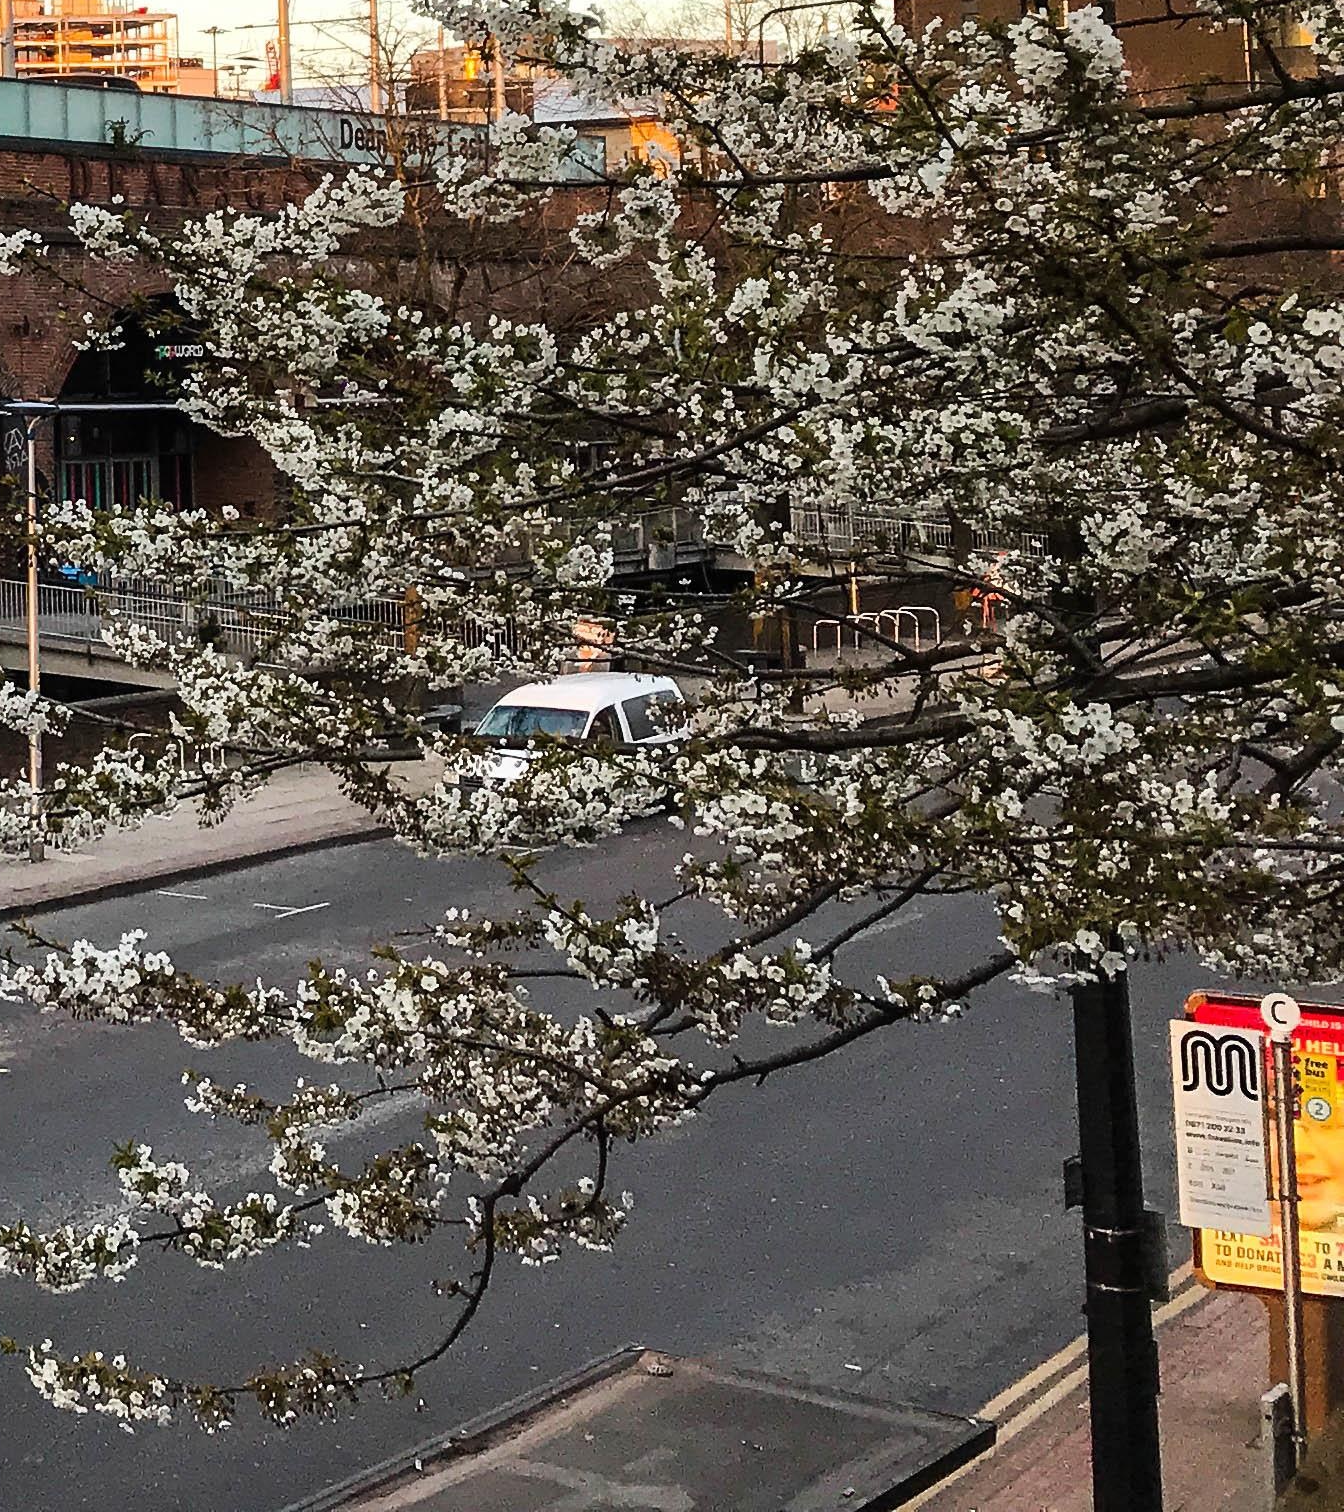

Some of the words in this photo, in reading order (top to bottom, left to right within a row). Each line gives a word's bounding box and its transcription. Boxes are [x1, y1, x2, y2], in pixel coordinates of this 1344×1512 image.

[1270, 1000, 1288, 1025] C
[1305, 1039, 1344, 1057] HEL
[1305, 1057, 1329, 1070] free
[1305, 1068, 1326, 1079] bus
[1314, 1102, 1324, 1116] 2
[1214, 1243, 1232, 1257] TO
[1236, 1246, 1282, 1264] DONAT
[1314, 1241, 1331, 1255] TO
